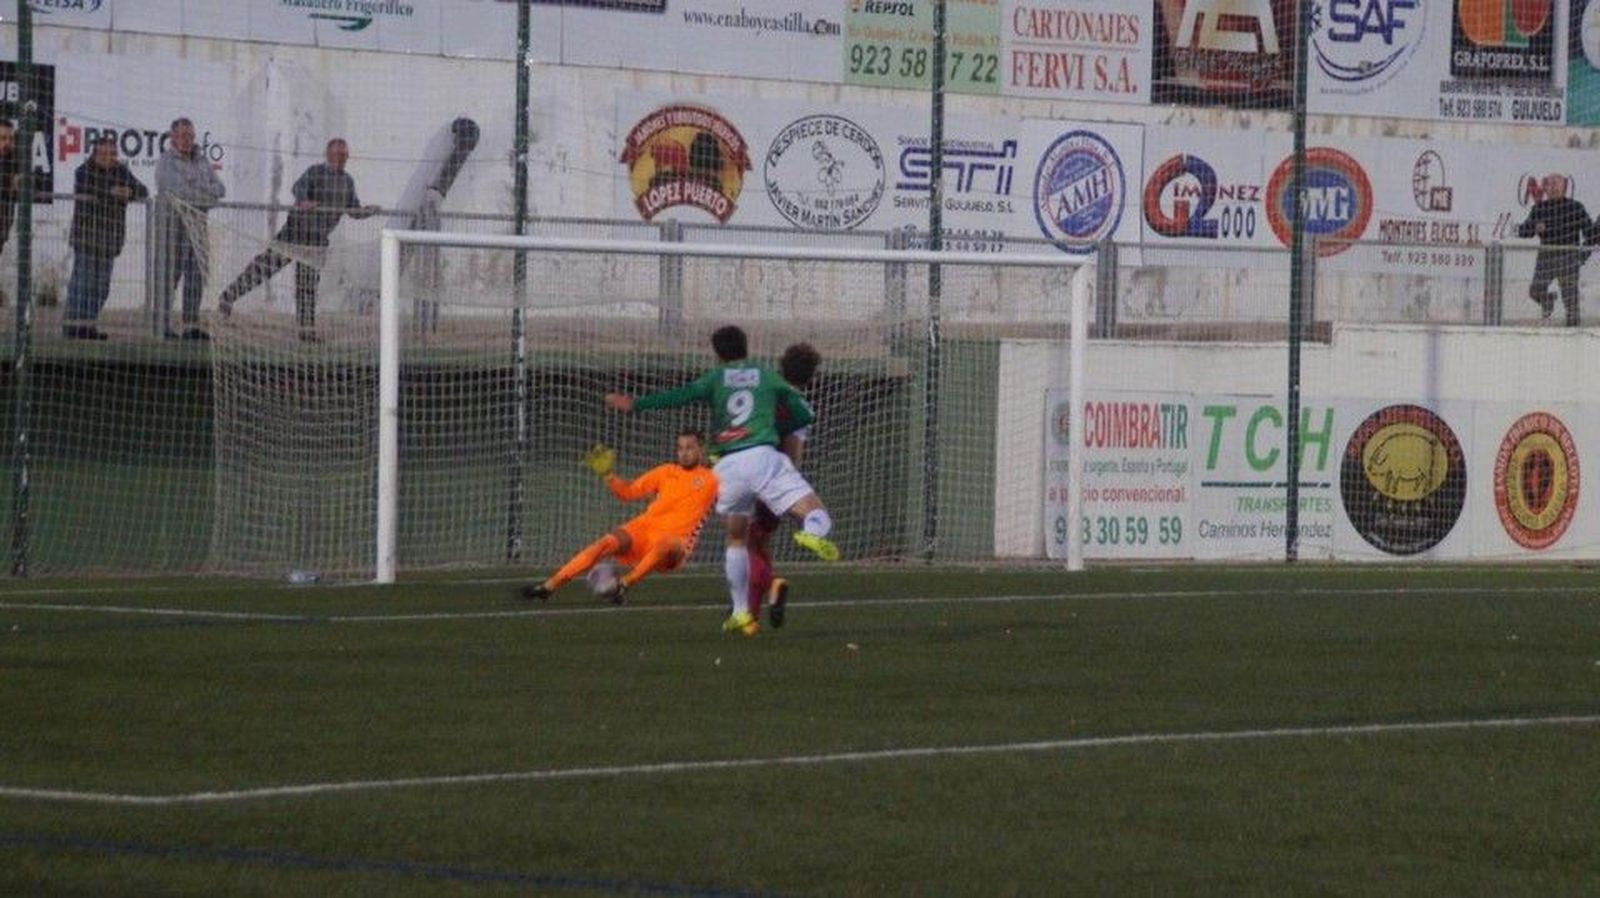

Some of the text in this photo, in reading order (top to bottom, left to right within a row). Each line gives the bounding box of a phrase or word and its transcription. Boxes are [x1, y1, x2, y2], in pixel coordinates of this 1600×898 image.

[1013, 6, 1139, 44] CARTONAJES
[1327, 0, 1417, 45] SAF
[851, 44, 891, 75] 923
[900, 48, 927, 77] 58
[971, 52, 998, 82] 22
[1012, 49, 1084, 90] FERVI
[1093, 55, 1138, 94] S.A.
[825, 120, 840, 137] DE
[1056, 168, 1108, 221] AMH
[726, 389, 754, 426] 9
[1084, 402, 1189, 449] COIMBRATIR
[1096, 515, 1121, 545] 30
[1125, 515, 1149, 545] 59
[1158, 515, 1183, 545] 59
